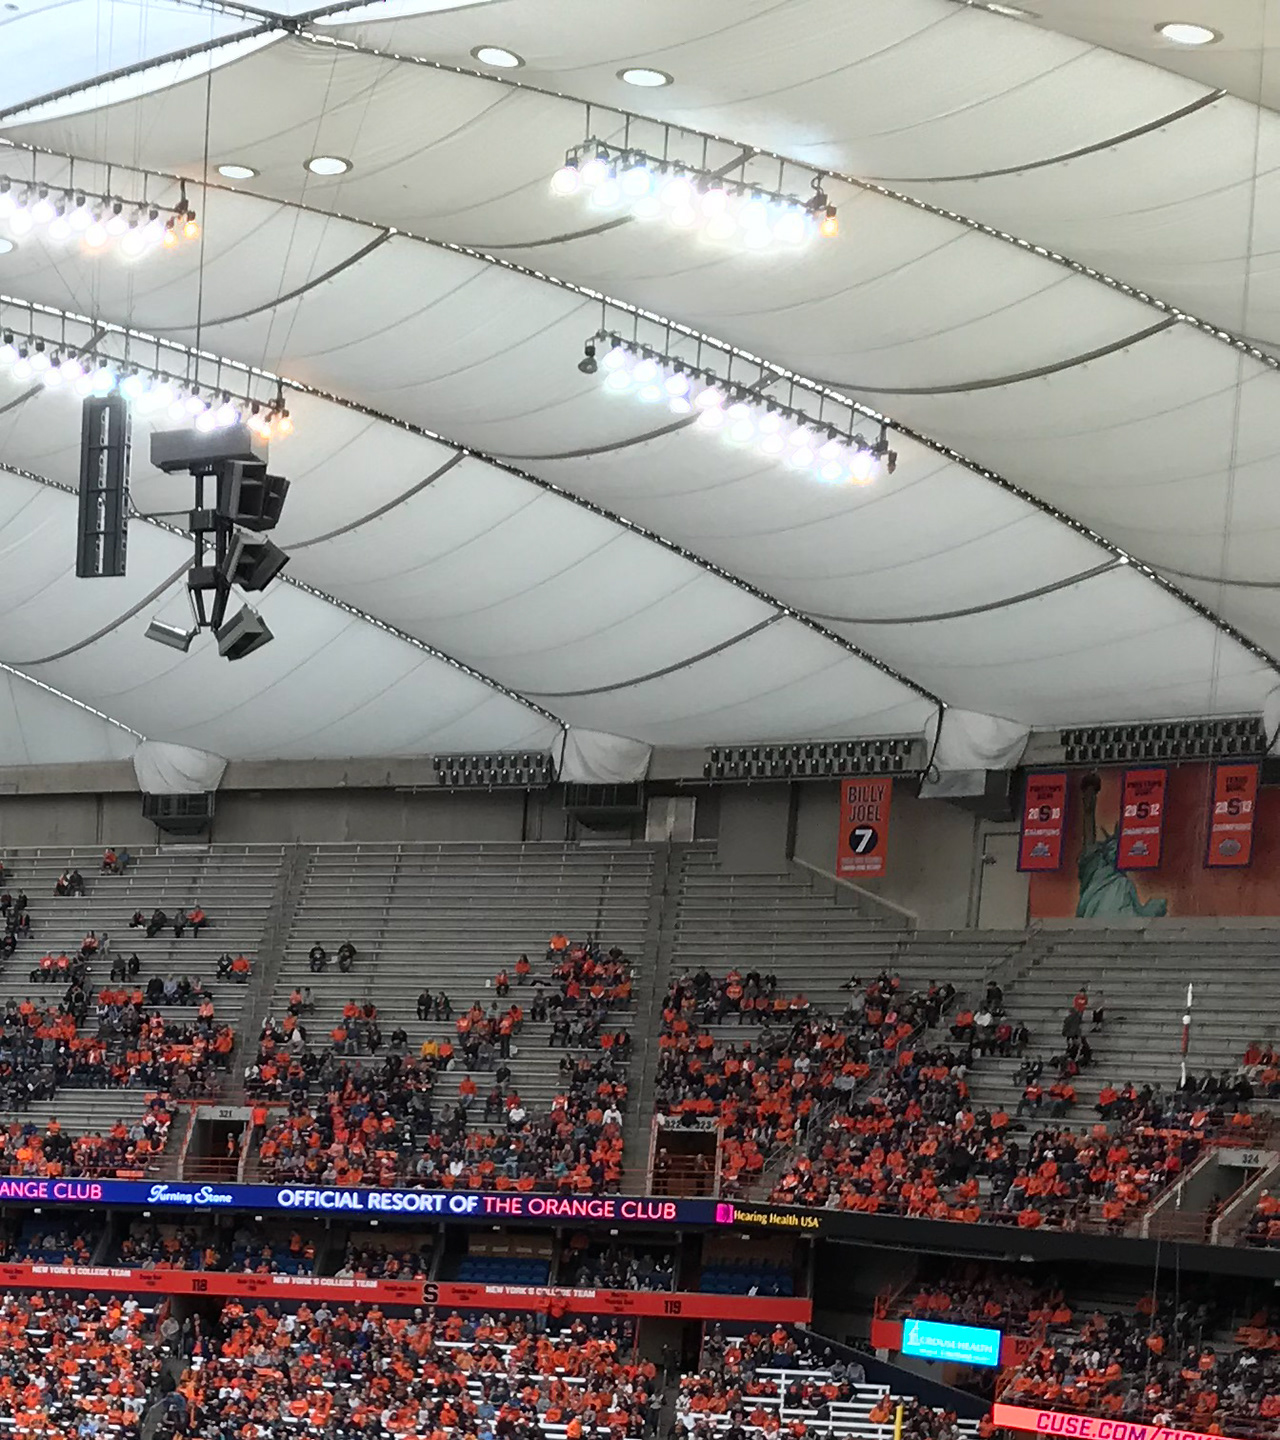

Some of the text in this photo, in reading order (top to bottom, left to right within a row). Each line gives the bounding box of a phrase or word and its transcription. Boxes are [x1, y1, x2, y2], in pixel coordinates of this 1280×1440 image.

[848, 785, 886, 803] BILLY
[849, 804, 882, 822] JOEL
[855, 828, 873, 853] 7
[53, 1181, 102, 1200] CLUB
[146, 1184, 233, 1205] Turning Stone
[277, 1189, 677, 1220] OFFICIAL RESORT OF THE ORANGE CLUB
[734, 1209, 820, 1229] Hearing Health USA
[273, 1275, 378, 1288] NEW YORK'S COLLEGE TEAM
[422, 1282, 439, 1303] S
[664, 1300, 683, 1315] 119
[957, 1341, 993, 1354] HEALTH
